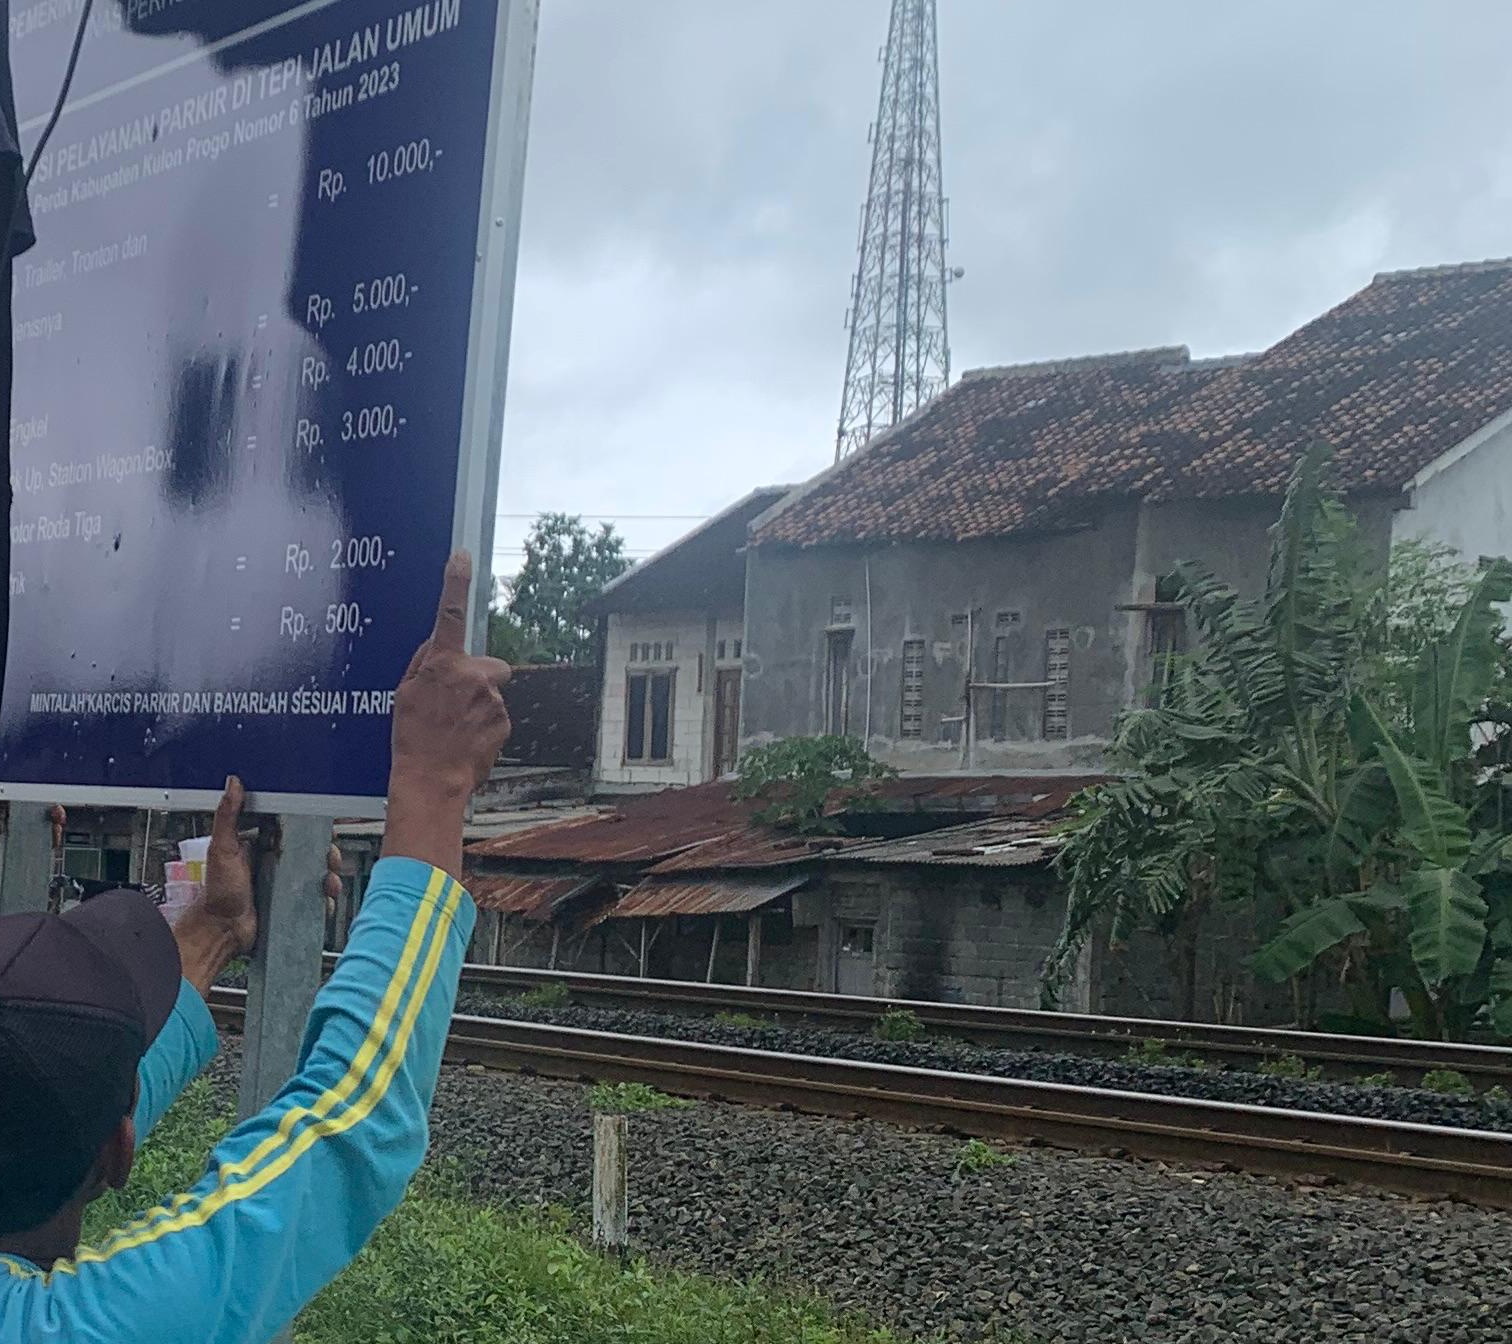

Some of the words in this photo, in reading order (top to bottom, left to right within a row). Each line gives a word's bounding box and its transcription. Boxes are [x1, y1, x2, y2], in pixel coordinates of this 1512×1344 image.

[56, 112, 155, 176] PELAYANAN
[158, 86, 227, 137] PARKIR
[232, 74, 253, 110] DI
[258, 54, 303, 100] TEPI
[306, 24, 380, 81] JALAN
[71, 162, 139, 203] Kabupaten
[143, 146, 182, 177] Kulon
[187, 131, 230, 162] Progo
[234, 108, 286, 145] Nomor
[289, 99, 299, 126] 6
[304, 84, 354, 121] Tahun
[358, 61, 401, 103] 2023
[318, 168, 347, 202] Rp.
[367, 138, 443, 184] 10.000,-
[122, 233, 148, 260] dan
[307, 294, 336, 329] Rp.
[352, 273, 419, 313] 5.000,-
[301, 356, 330, 391] Rp.
[346, 339, 413, 377] 4.000,-
[296, 419, 324, 453] Rp.
[341, 404, 407, 441] 3.000,-
[48, 461, 92, 489] Station
[38, 515, 70, 542] Roda
[75, 511, 101, 542] Tiga
[285, 544, 314, 579] Rp.
[330, 536, 395, 570] 2.000,-
[280, 606, 309, 642] Rp.
[325, 602, 372, 638] 500,-
[30, 692, 86, 714] MINTALAH
[87, 692, 132, 714] KARCIS
[133, 692, 180, 714] PARKIR
[183, 692, 211, 714] DAN
[213, 691, 288, 715] BAYARLAH
[291, 690, 347, 715] SESUAI
[351, 690, 395, 715] TARIF
